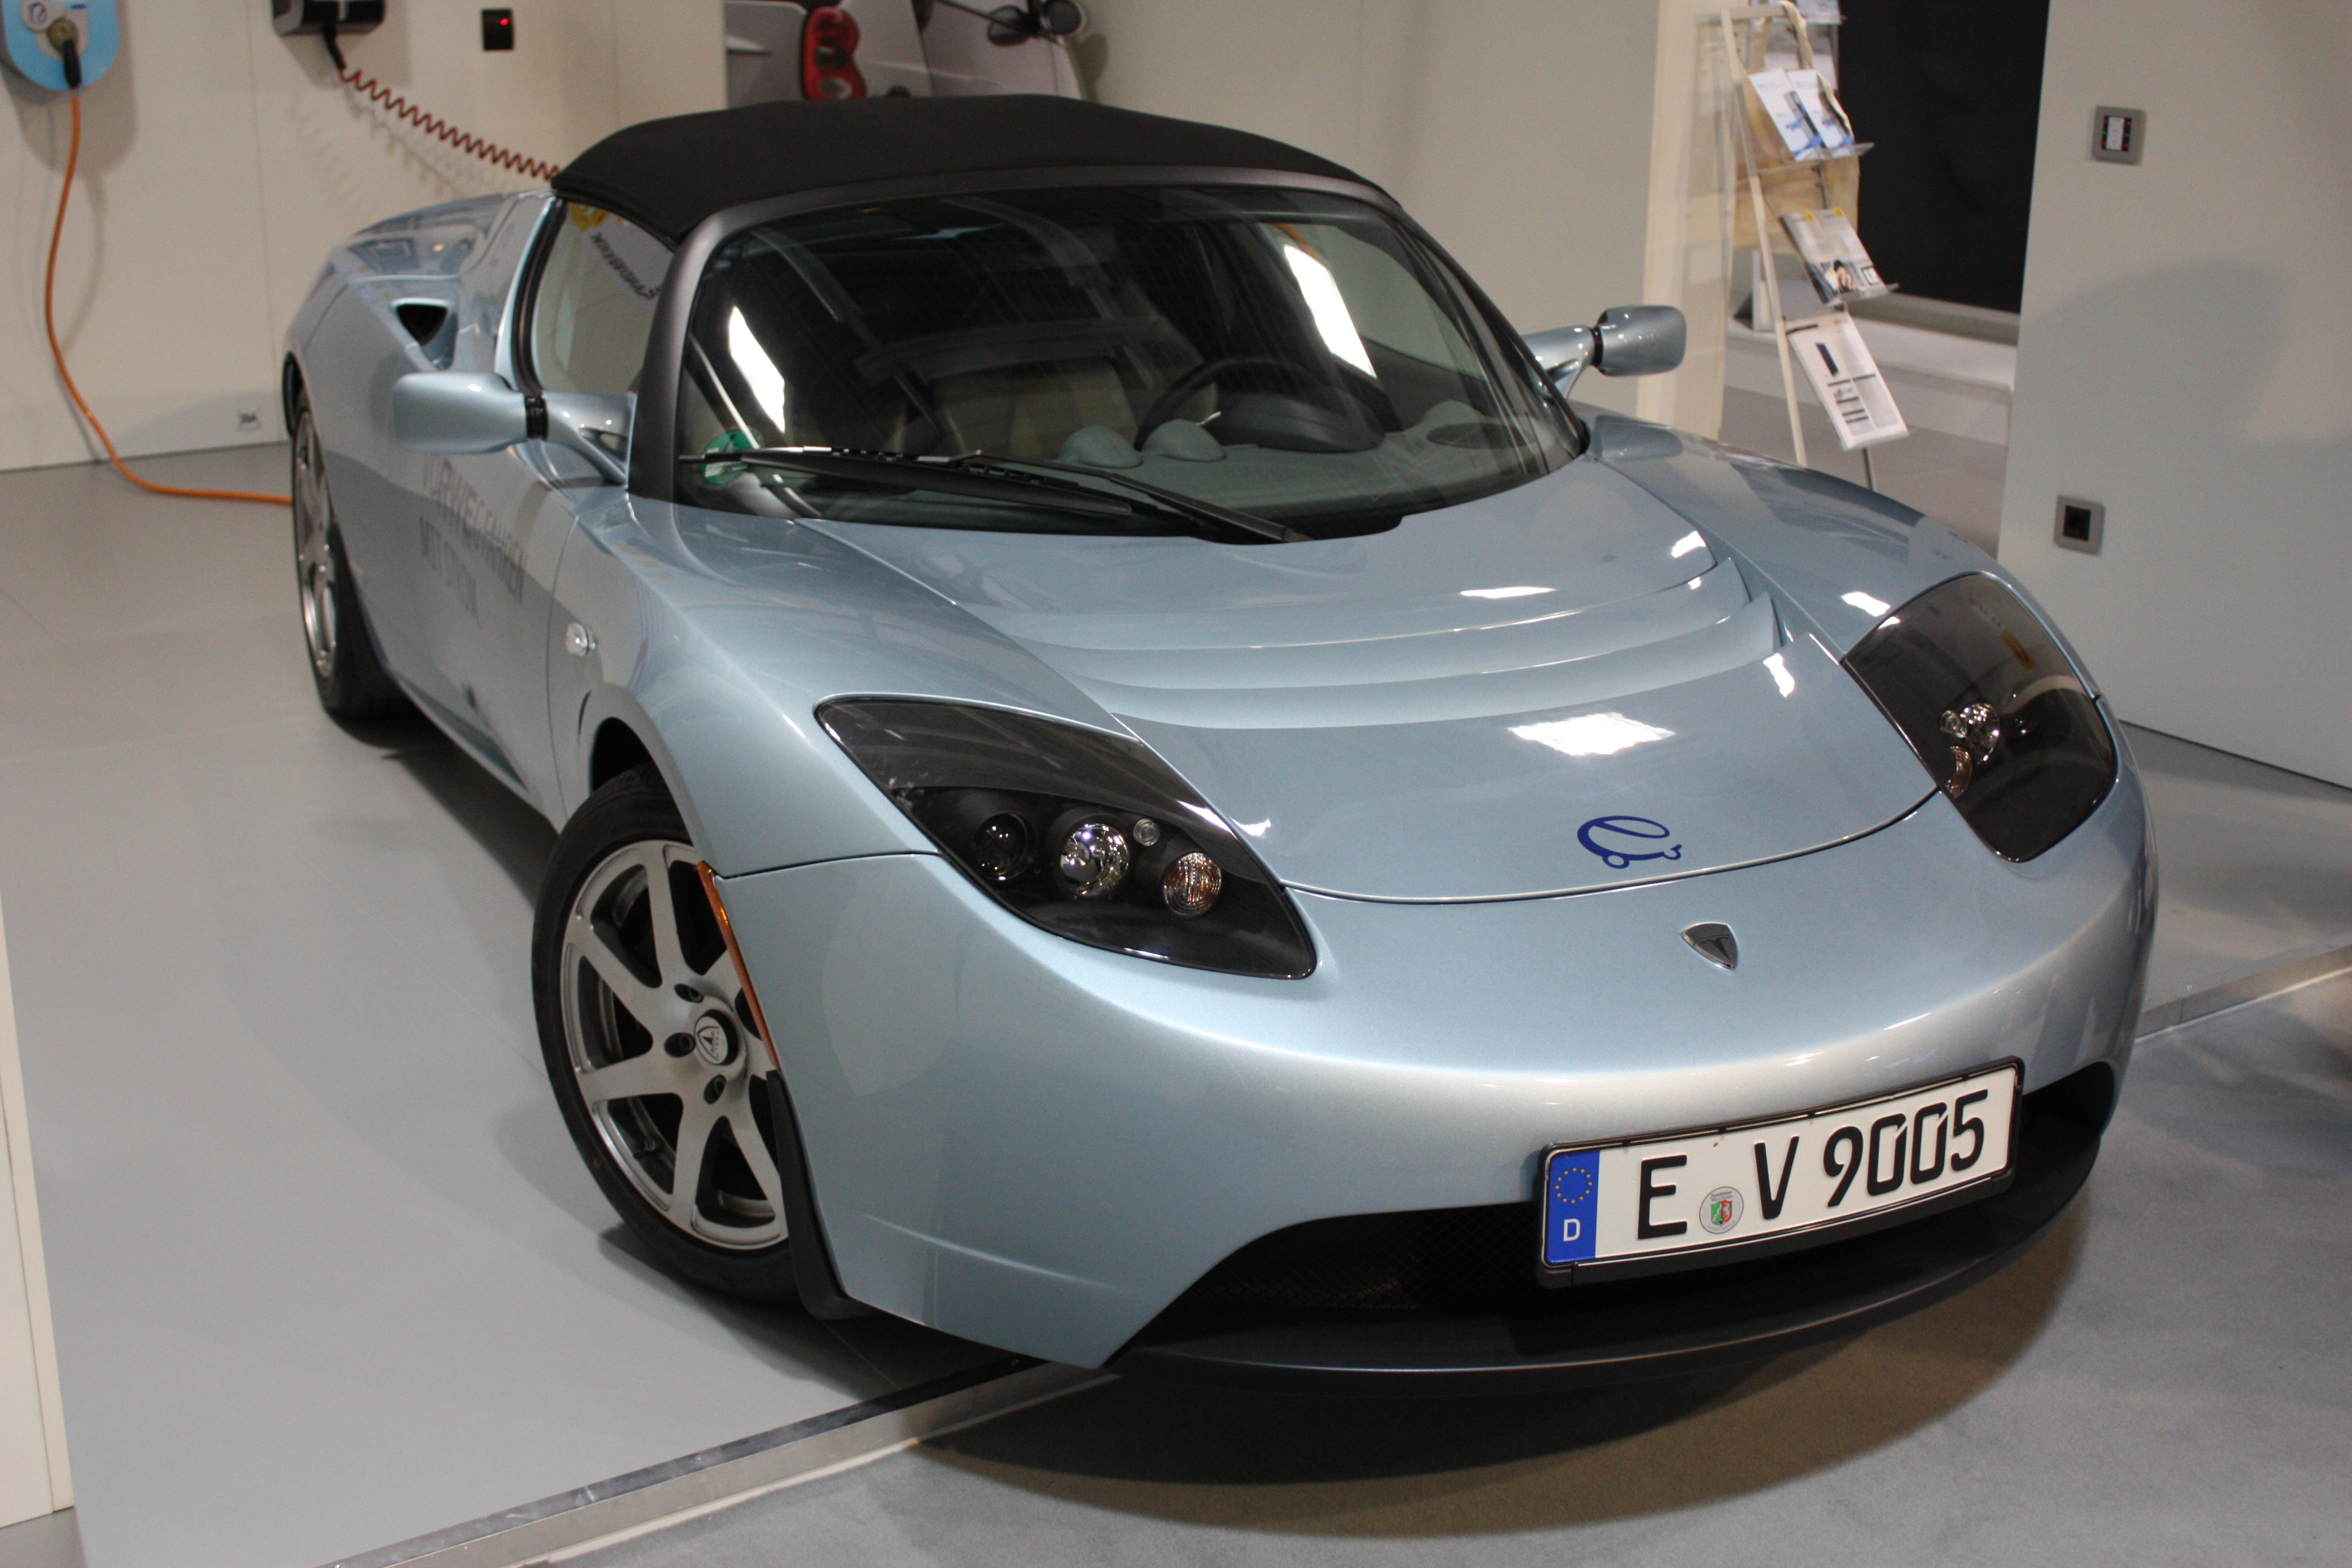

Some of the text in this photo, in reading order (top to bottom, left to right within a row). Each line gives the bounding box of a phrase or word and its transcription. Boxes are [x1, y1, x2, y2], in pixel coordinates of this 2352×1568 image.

[1637, 1088, 1988, 1239] E V 9005
[1562, 1219, 1581, 1242] D
